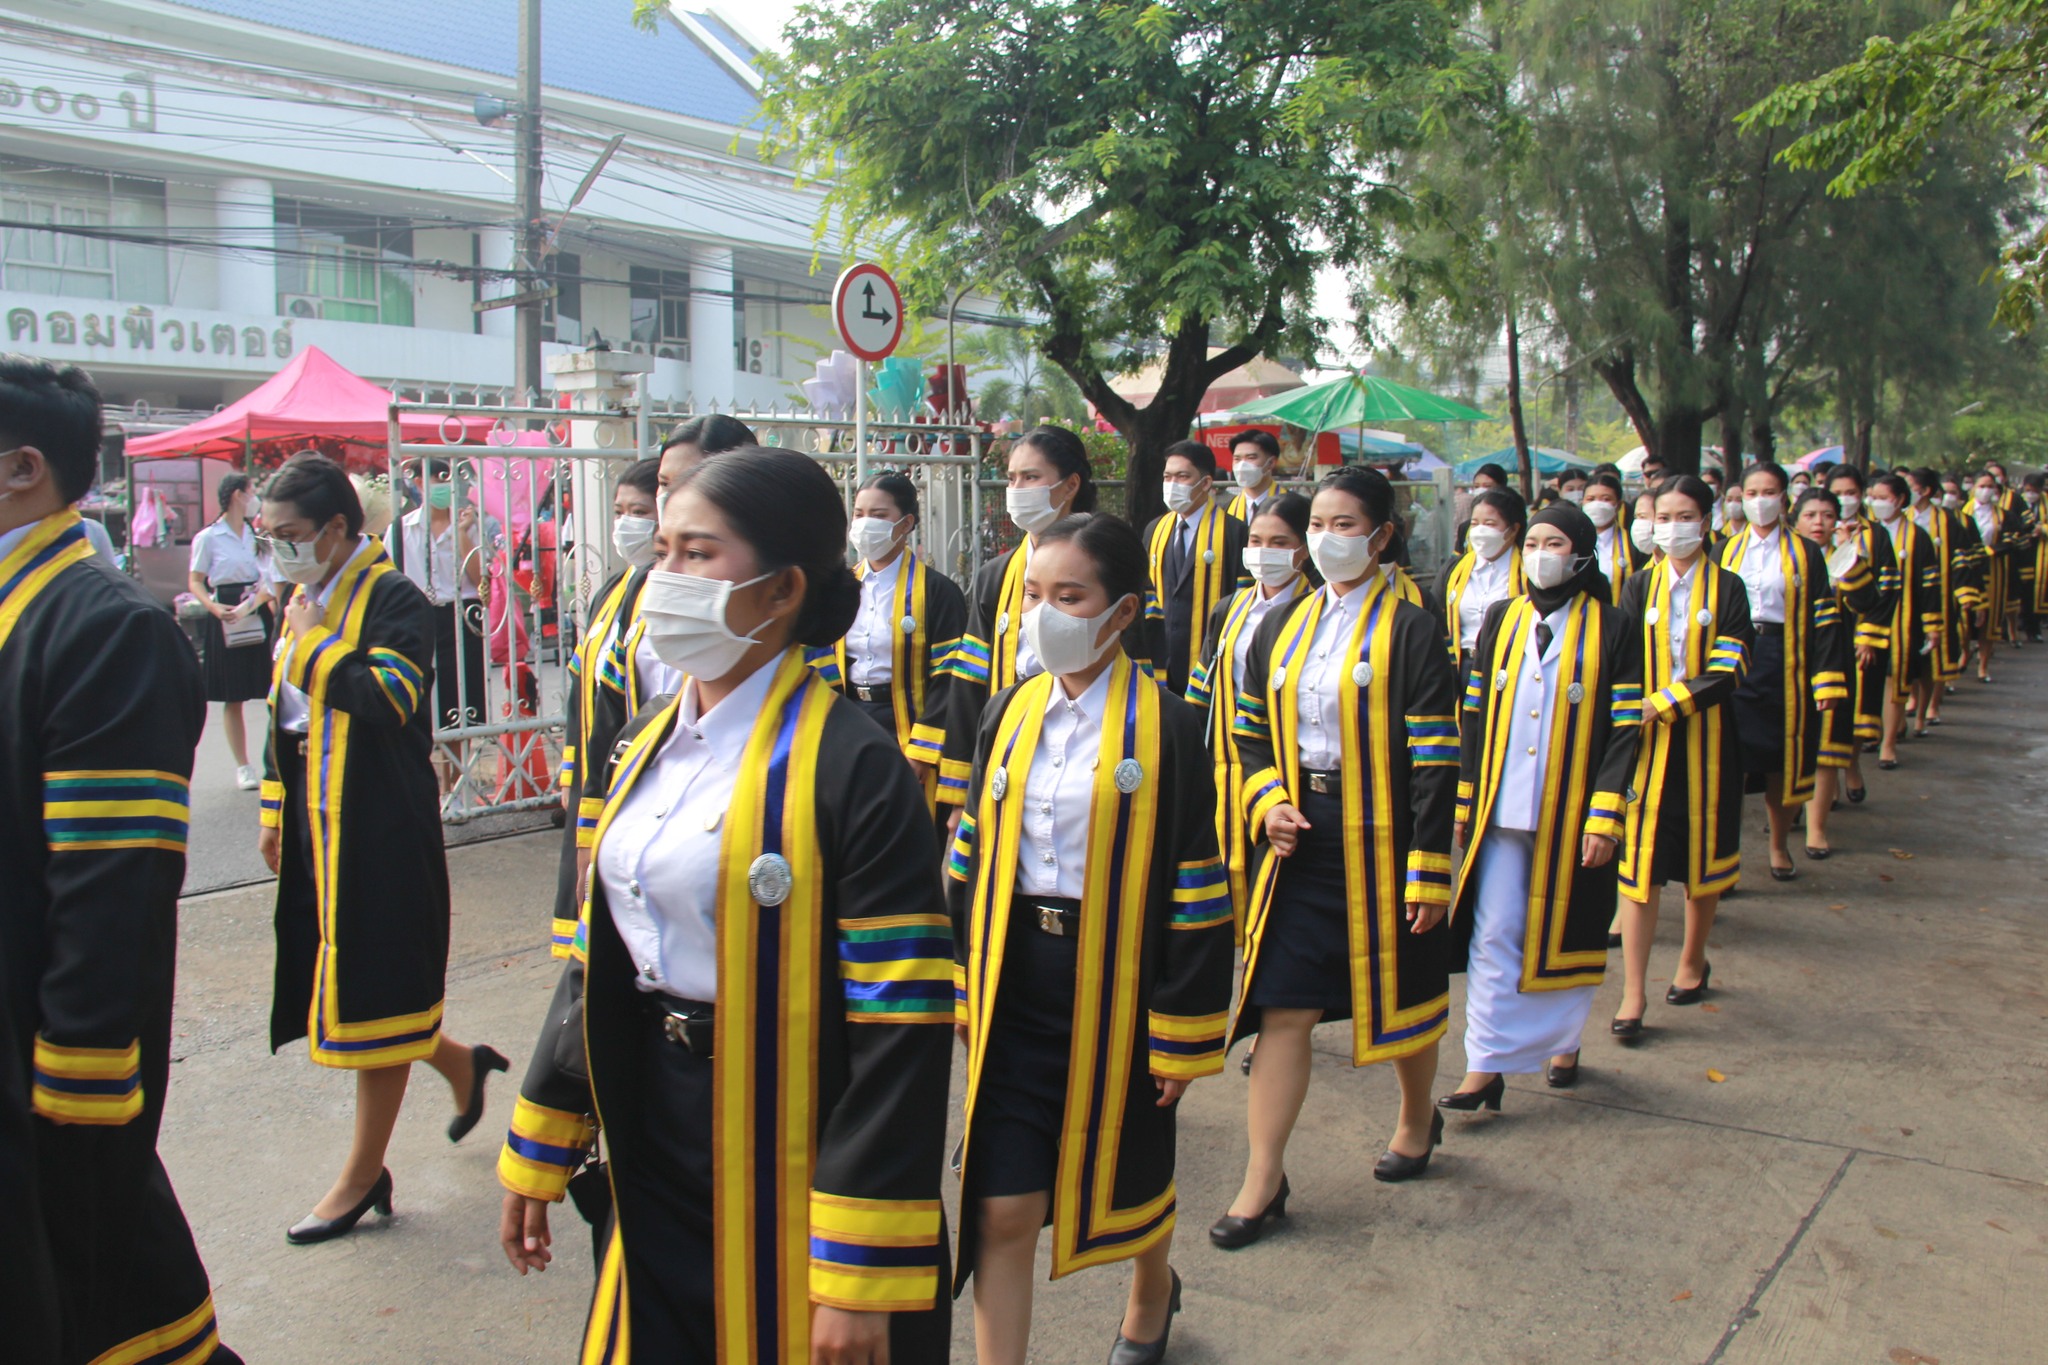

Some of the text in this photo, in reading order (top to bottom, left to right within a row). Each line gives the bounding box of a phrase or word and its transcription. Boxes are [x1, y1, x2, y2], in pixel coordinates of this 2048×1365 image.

[6, 305, 295, 358] คอมพิวเตอร์
[1206, 433, 1231, 448] NES
